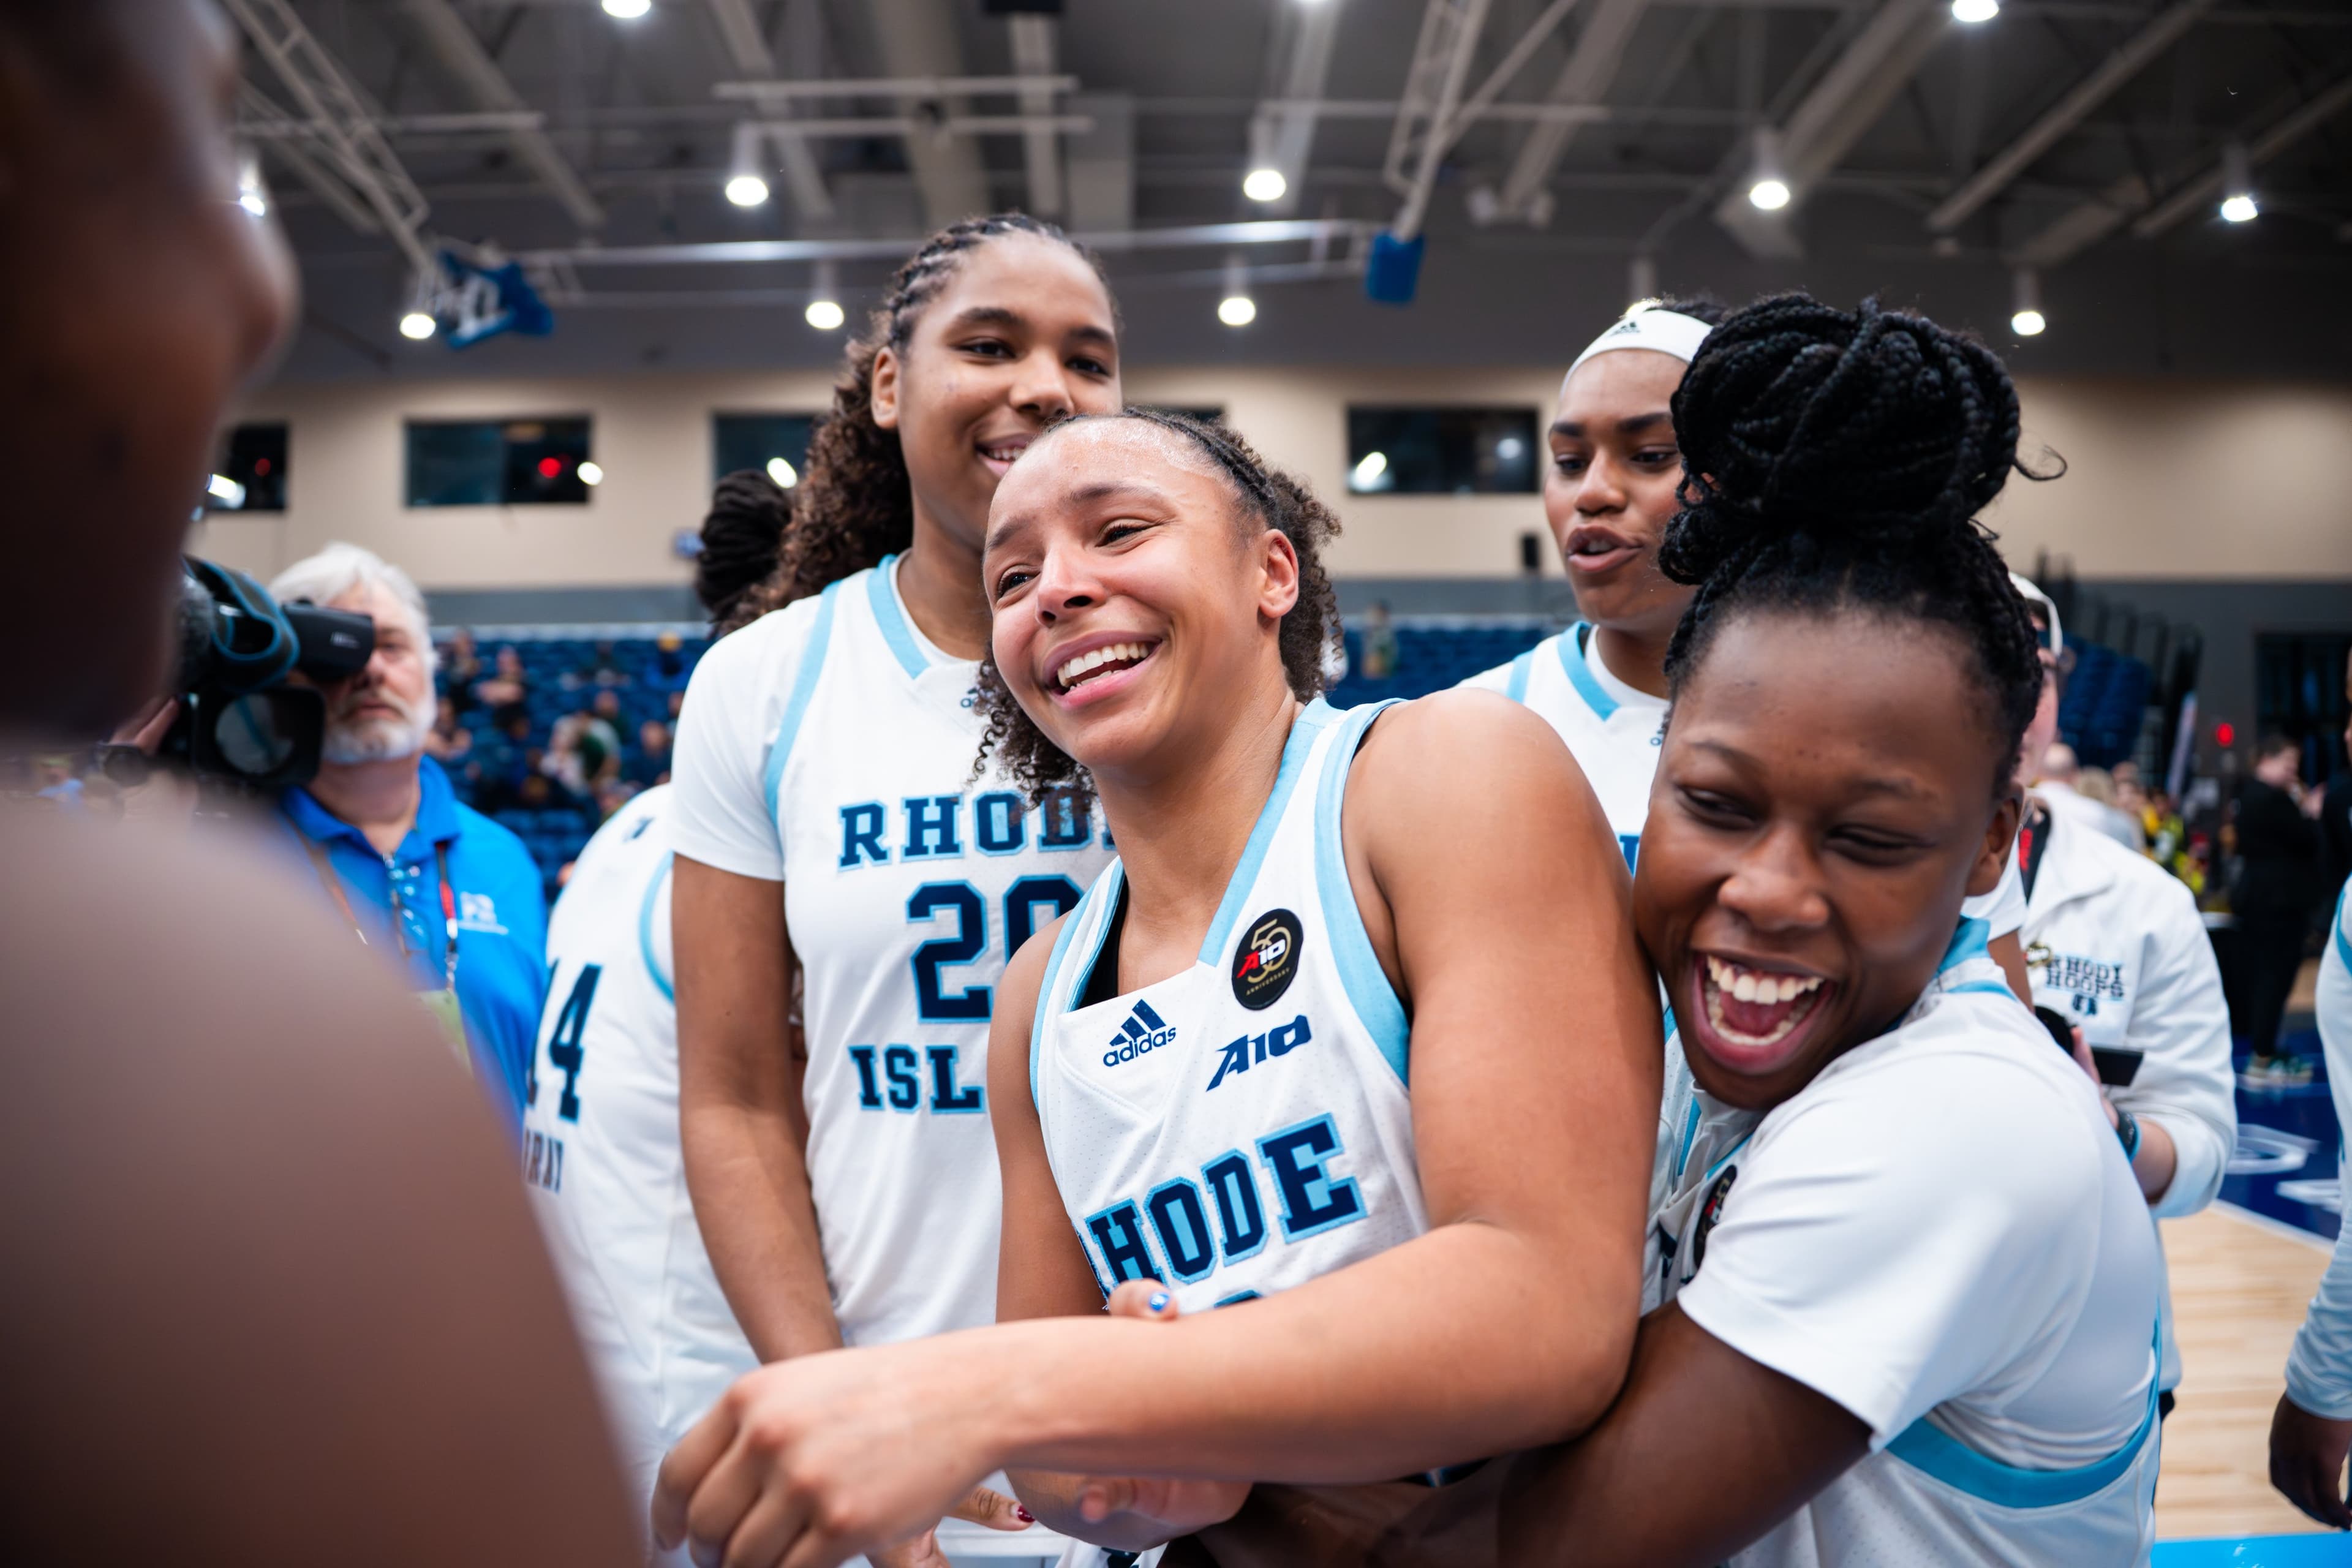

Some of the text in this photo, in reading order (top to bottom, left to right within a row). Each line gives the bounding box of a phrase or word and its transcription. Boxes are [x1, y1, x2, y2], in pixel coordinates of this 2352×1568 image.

[837, 786, 1117, 872] RHOD
[1237, 938, 1286, 979] A10
[1103, 1027, 1176, 1067] adidas
[1205, 1014, 1311, 1092] A10
[1076, 1112, 1367, 1297] HODE
